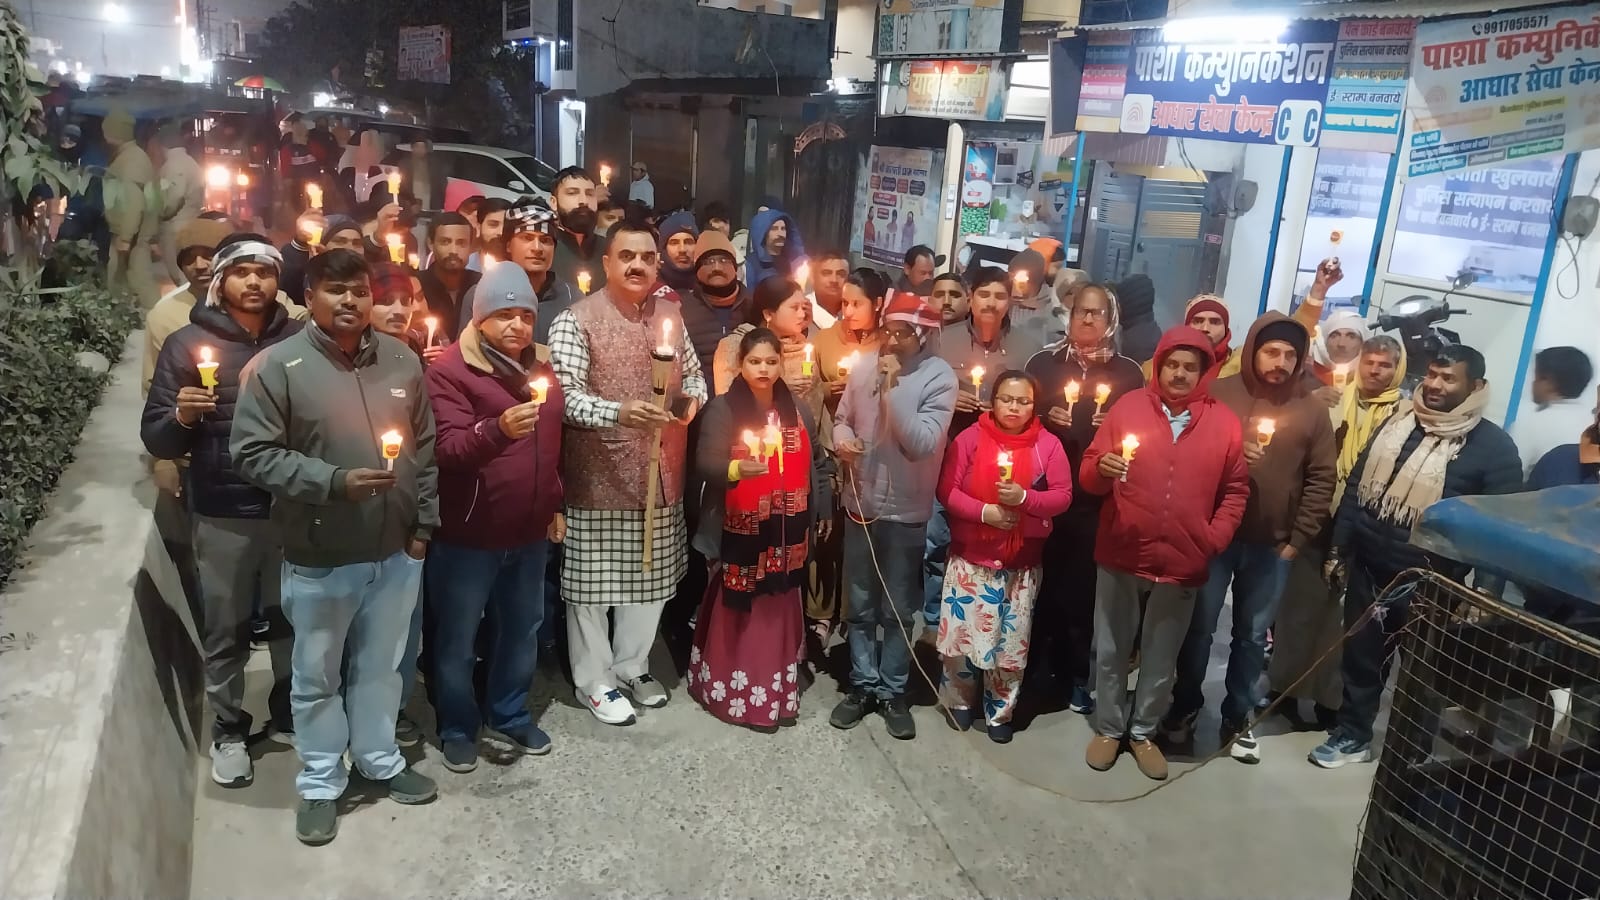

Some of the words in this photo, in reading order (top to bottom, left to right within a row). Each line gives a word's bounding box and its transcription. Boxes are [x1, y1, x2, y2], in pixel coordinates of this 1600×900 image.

[1135, 43, 1182, 82] पाशा
[1422, 38, 1490, 70] पाशा
[1526, 64, 1565, 92] सेवा
[1342, 92, 1367, 103] स्टाम्प
[1151, 100, 1199, 131] आधार
[1199, 94, 1236, 133] सेवा
[1235, 94, 1279, 138] केन्द्र
[1453, 191, 1507, 211] सत्यापन
